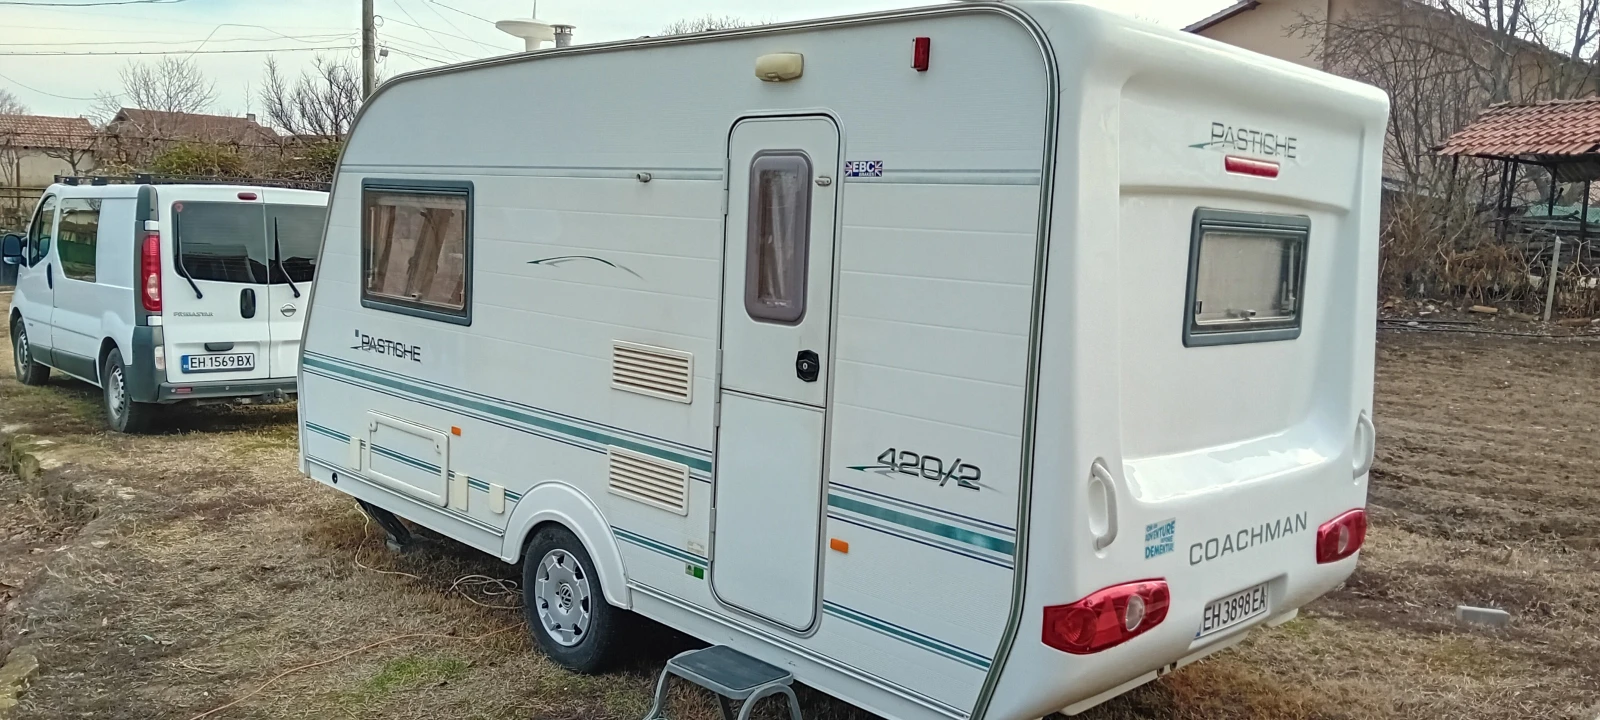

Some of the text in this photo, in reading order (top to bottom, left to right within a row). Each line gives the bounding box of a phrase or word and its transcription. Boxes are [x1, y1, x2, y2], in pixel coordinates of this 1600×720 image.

[1210, 121, 1297, 159] PASTICHE
[852, 161, 875, 173] EBC
[190, 357, 206, 369] EH
[209, 356, 235, 368] 1569
[237, 355, 252, 367] BX
[361, 334, 421, 362] PASTICHE
[877, 448, 982, 491] 420/2
[1145, 520, 1175, 542] ADVENTURE
[1189, 511, 1307, 566] COACHMAN
[1203, 586, 1267, 632] EH 3898 EA
